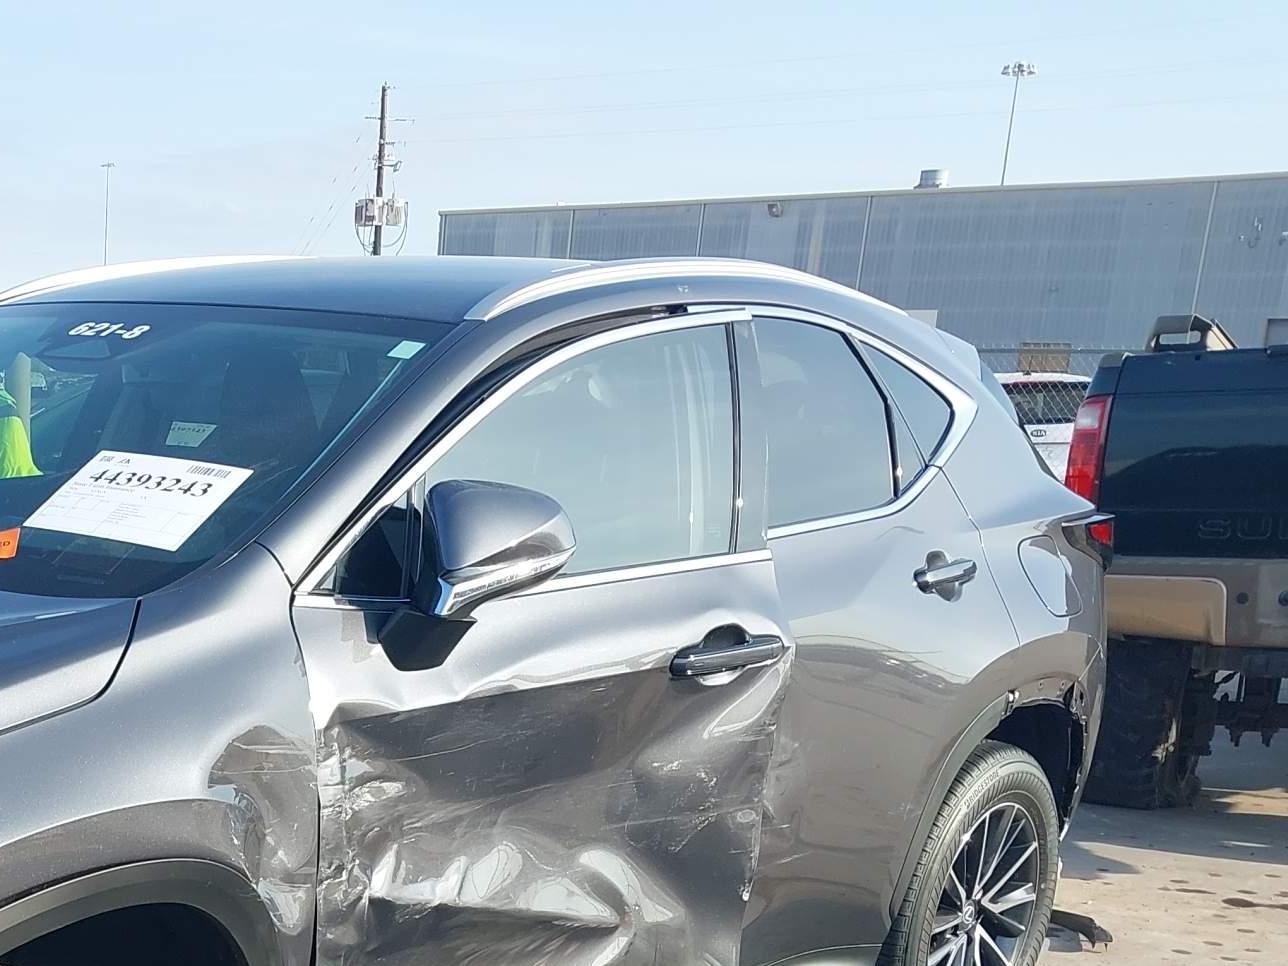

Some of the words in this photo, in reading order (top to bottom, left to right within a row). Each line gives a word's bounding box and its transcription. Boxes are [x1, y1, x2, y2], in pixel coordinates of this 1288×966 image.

[68, 322, 151, 339] 621-8
[1031, 429, 1046, 438] KIA
[89, 468, 214, 497] 44393243
